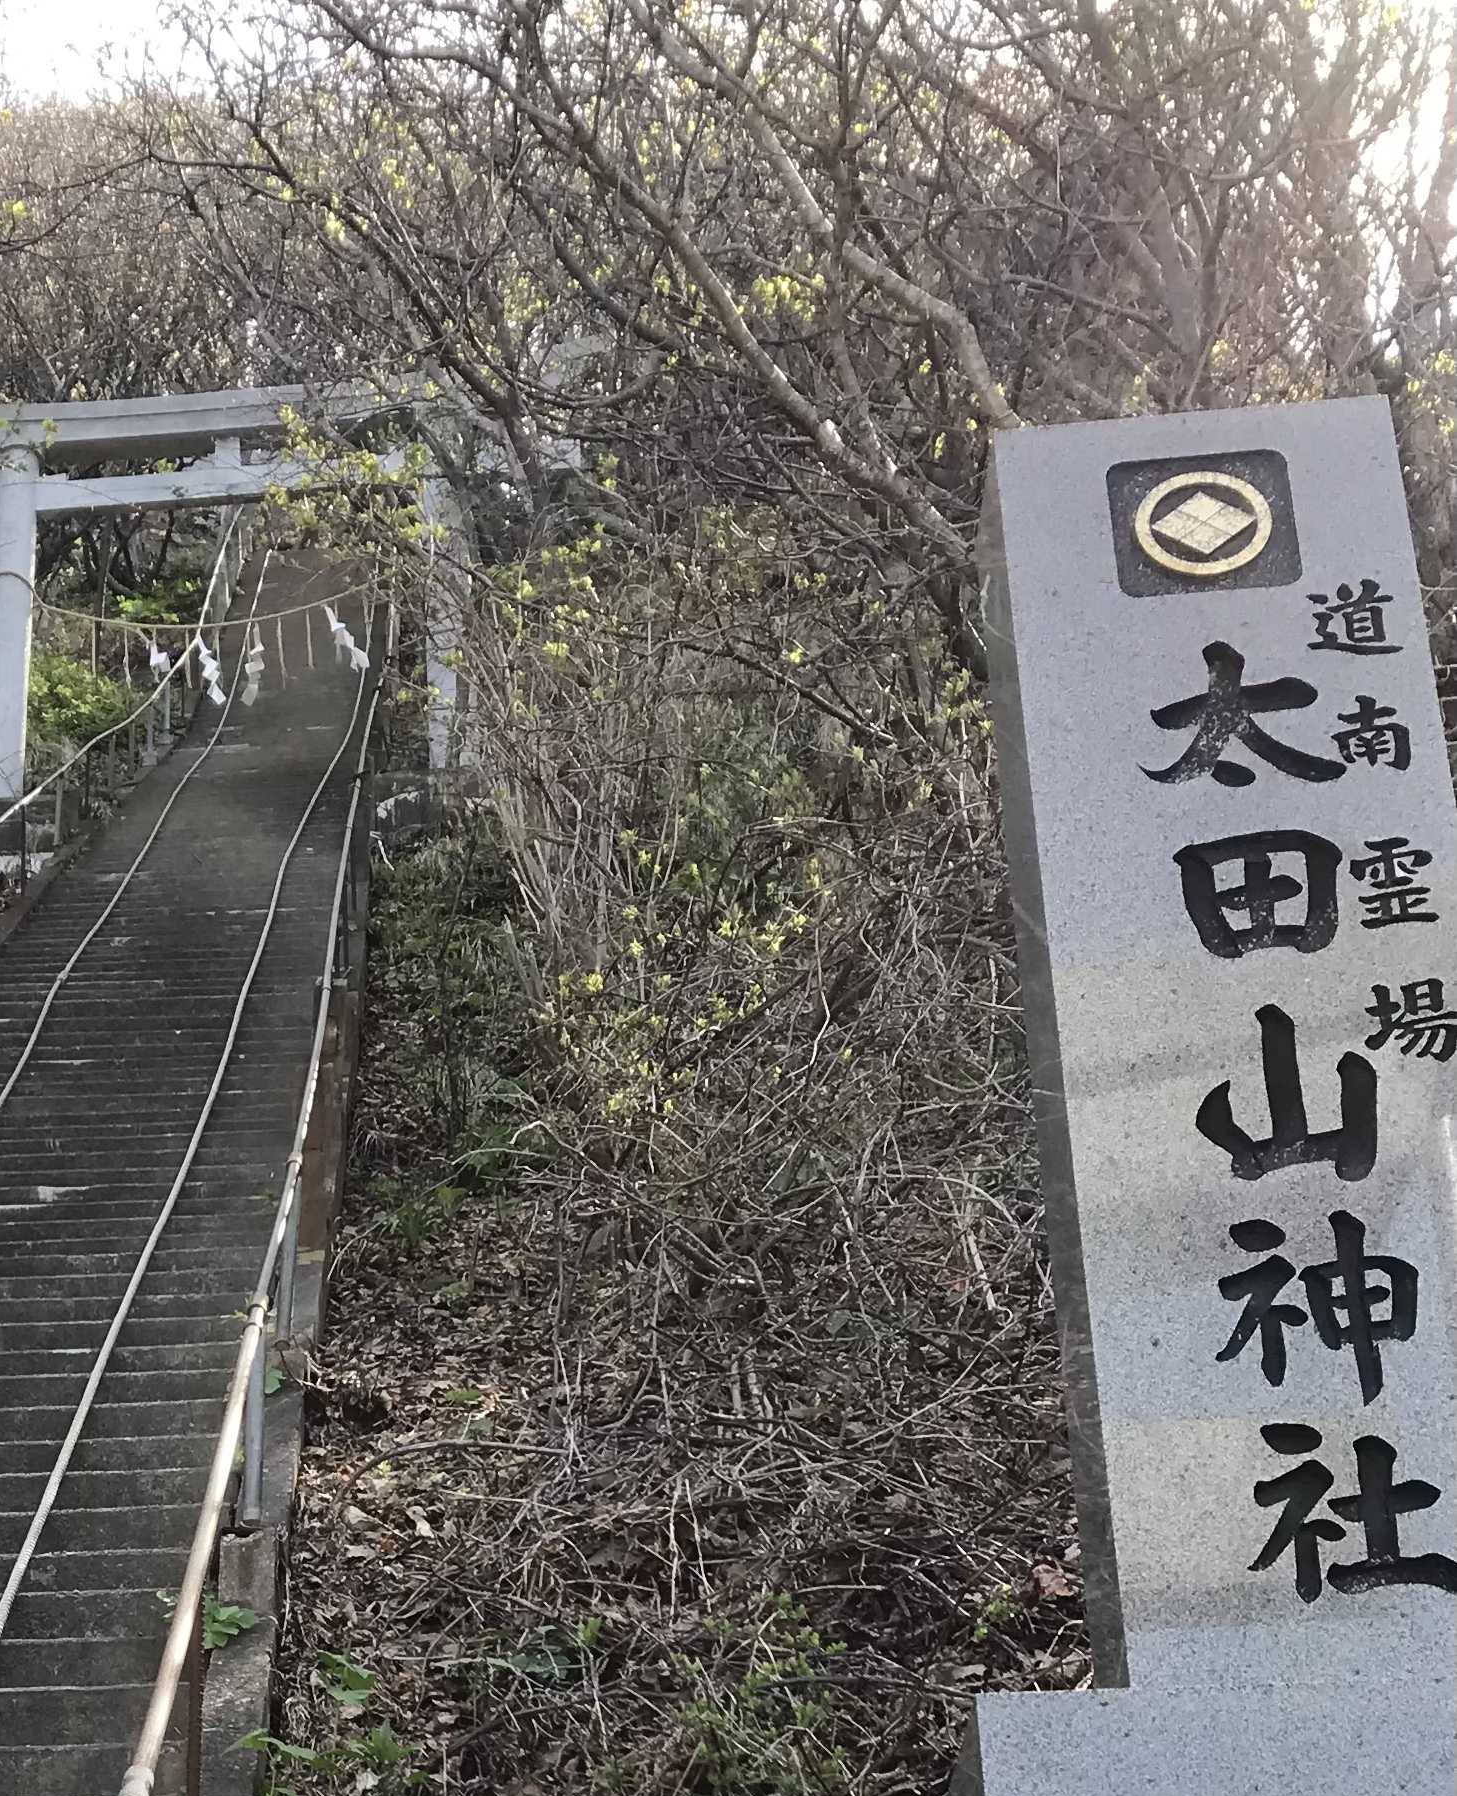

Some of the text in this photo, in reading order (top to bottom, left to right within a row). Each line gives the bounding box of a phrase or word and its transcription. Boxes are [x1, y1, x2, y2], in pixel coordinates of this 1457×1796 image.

[1137, 640, 1457, 1603] 太田山神社
[1306, 578, 1457, 1062] 道南霊場
